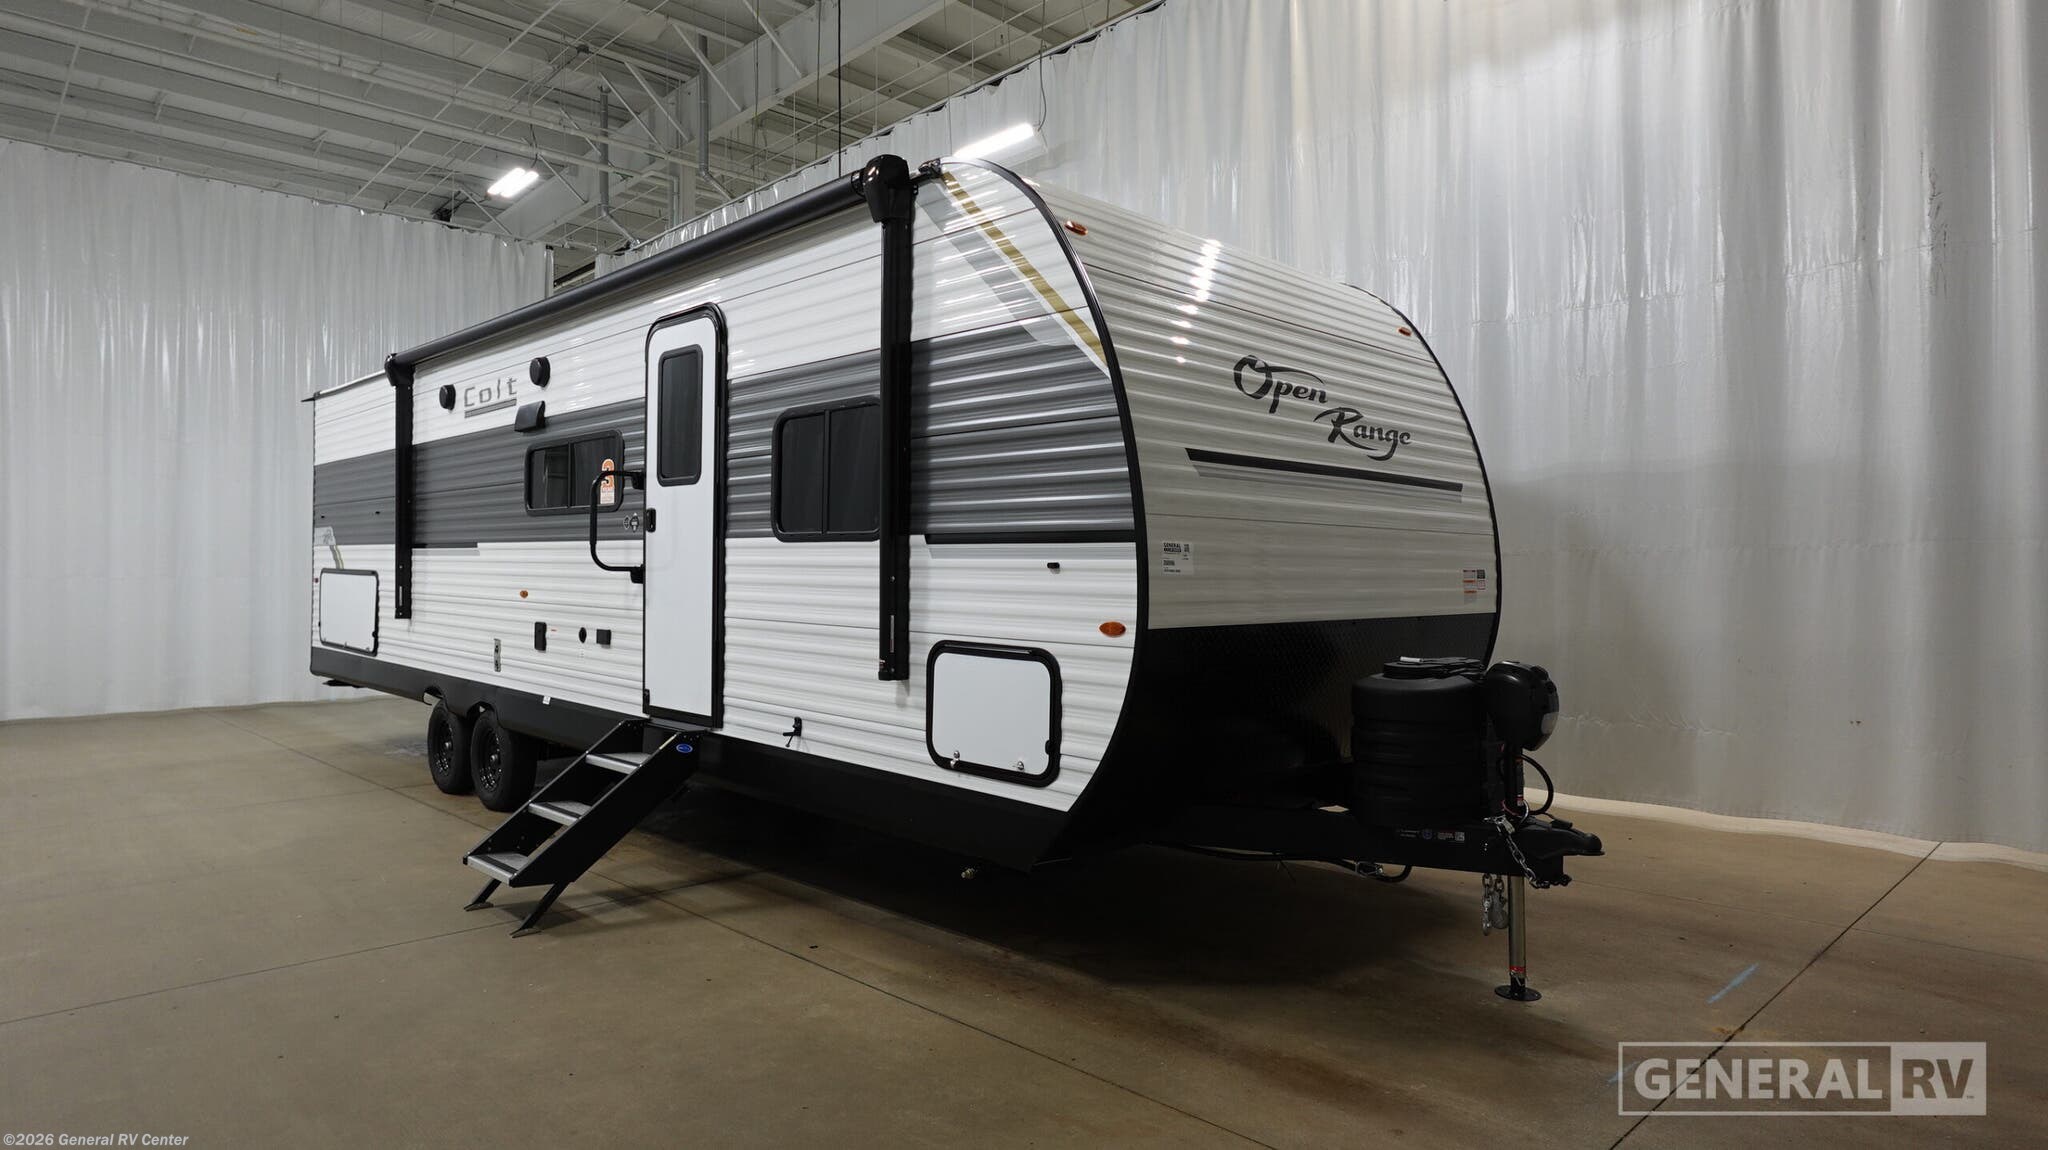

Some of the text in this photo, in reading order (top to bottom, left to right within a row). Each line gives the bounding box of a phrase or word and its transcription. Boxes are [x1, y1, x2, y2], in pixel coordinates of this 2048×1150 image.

[464, 377, 517, 407] Colt
[1233, 355, 1328, 414] Open
[1313, 406, 1412, 461] Range
